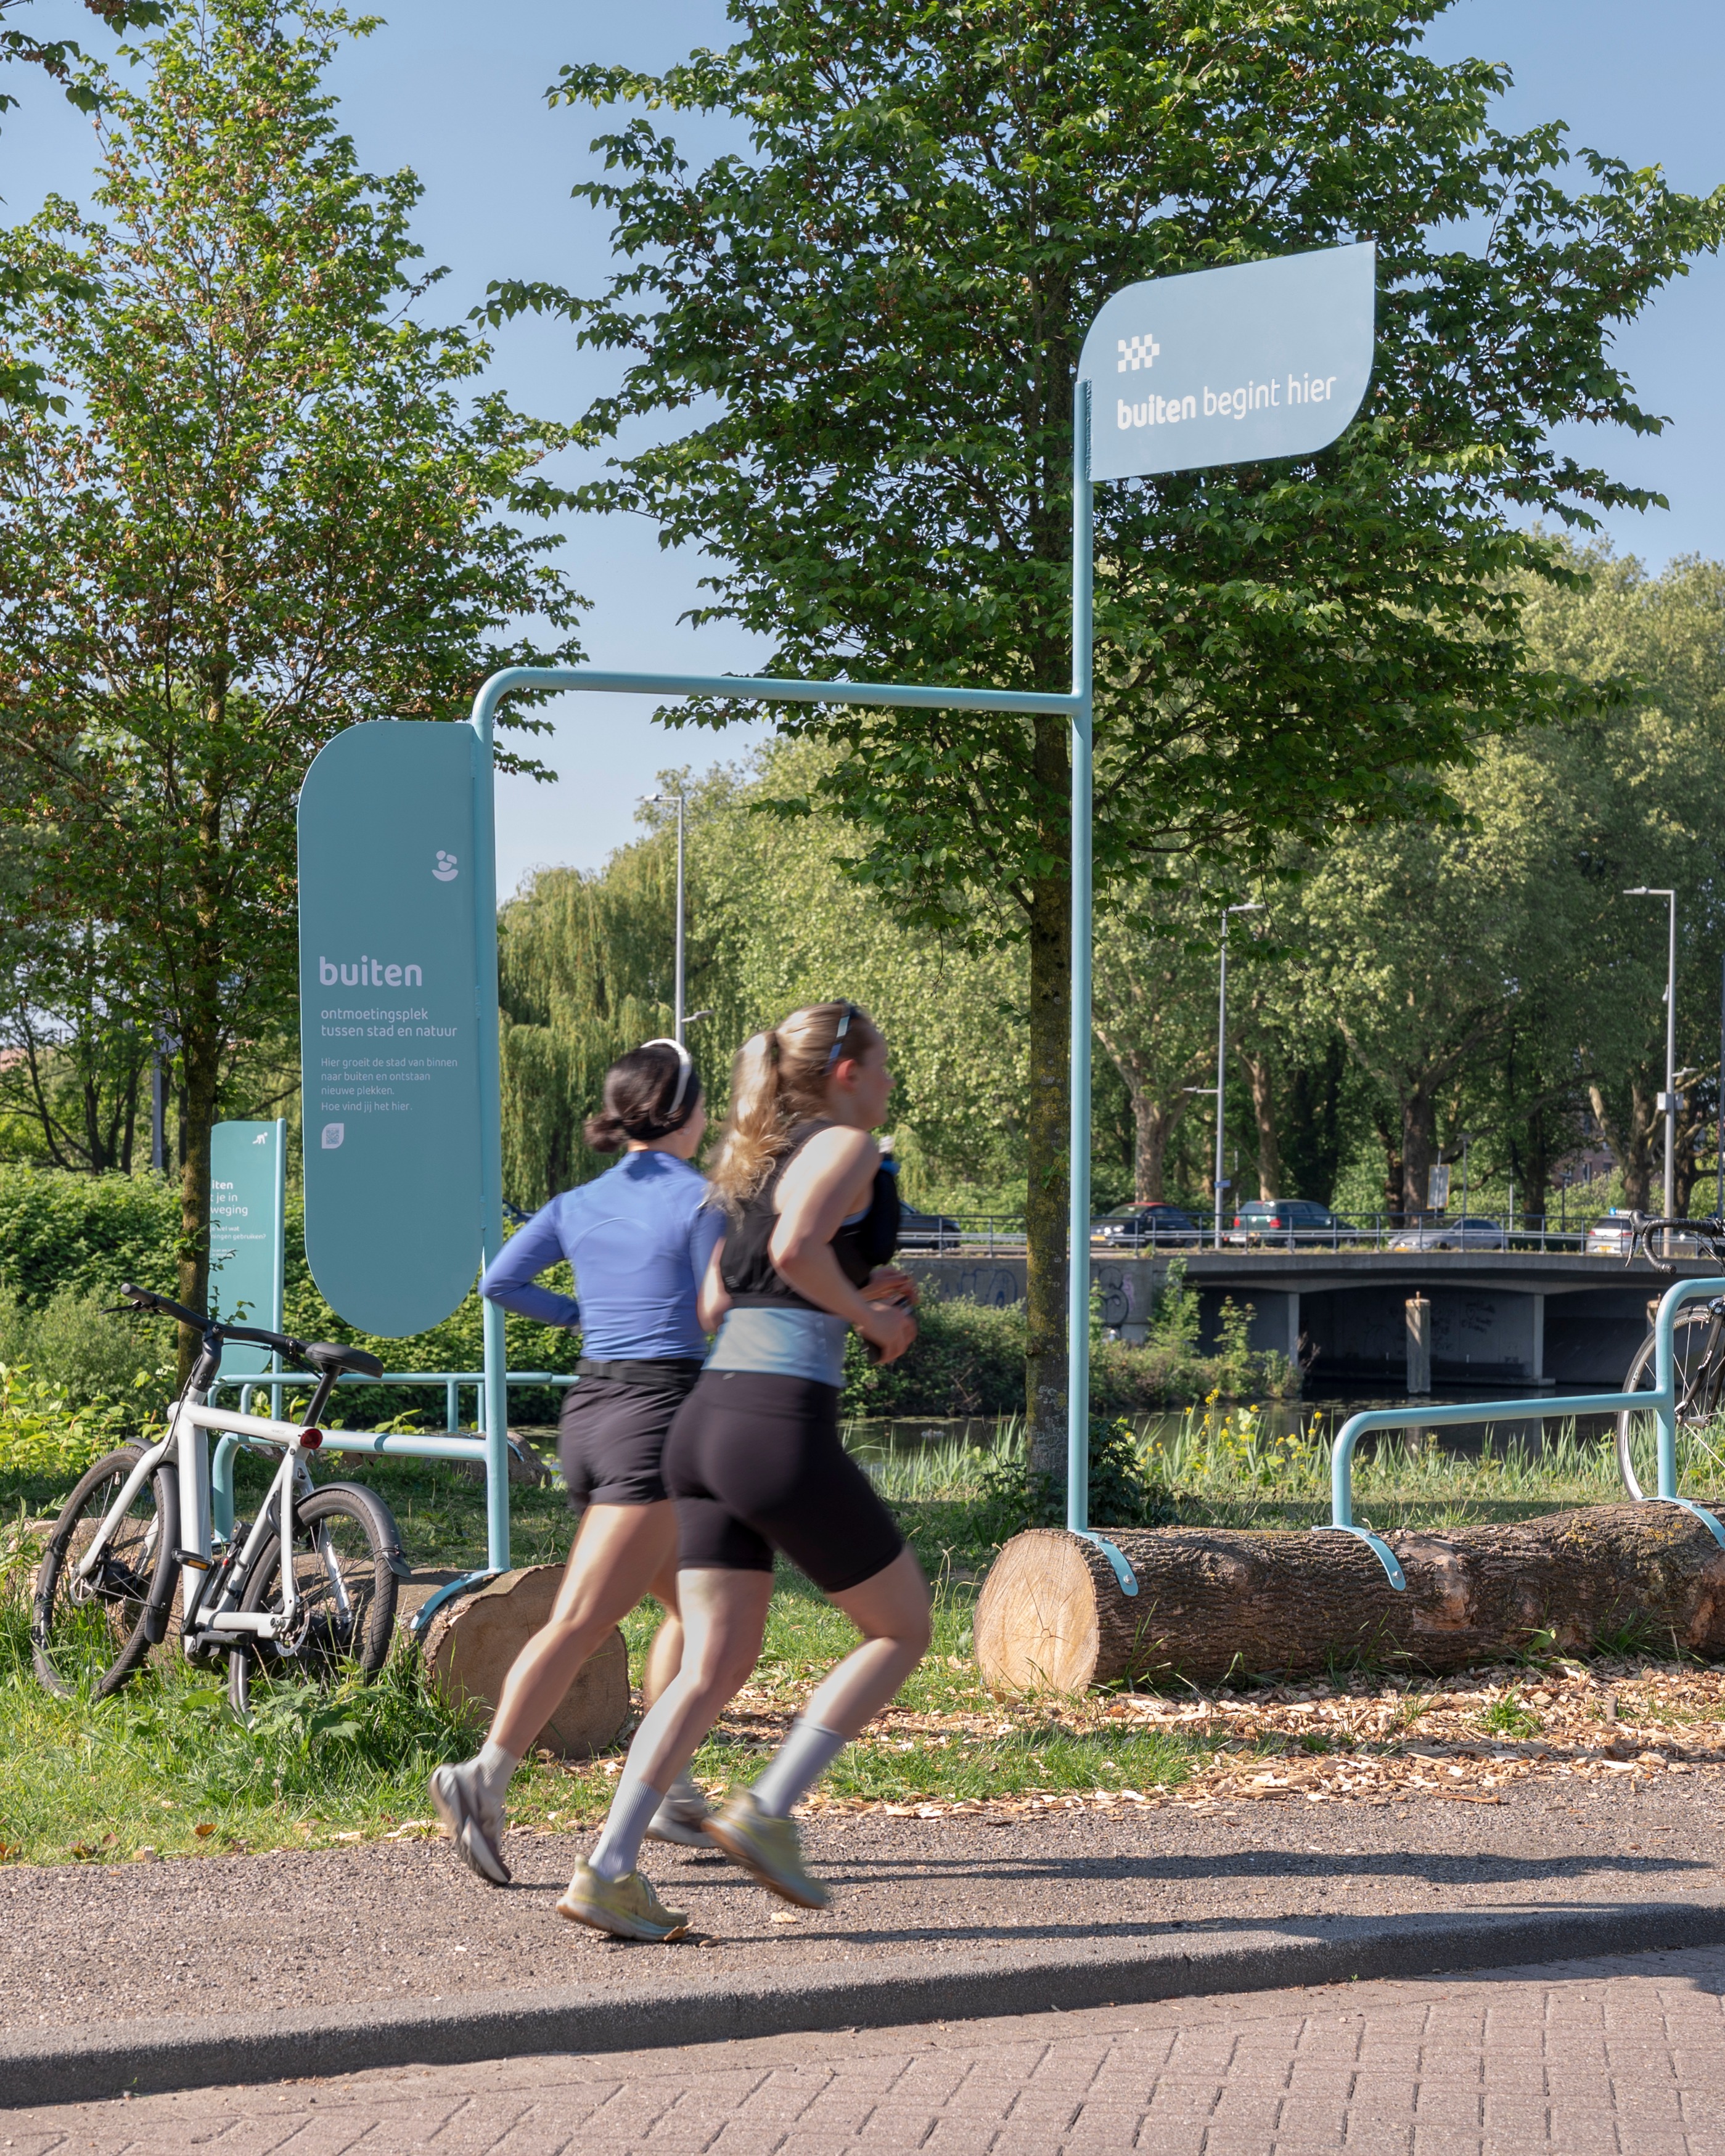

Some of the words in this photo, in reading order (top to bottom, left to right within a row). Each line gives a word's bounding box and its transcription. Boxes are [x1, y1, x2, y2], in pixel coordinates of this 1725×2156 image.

[1117, 394, 1196, 430] buiten
[1203, 378, 1280, 420] begint
[1288, 372, 1337, 405] hier
[319, 955, 422, 987] buiten
[321, 1007, 428, 1023] ontmoetingsplek
[321, 1025, 364, 1037] tussen
[367, 1024, 394, 1037] stad
[397, 1027, 412, 1037] en
[416, 1025, 457, 1037] natuur
[321, 1058, 340, 1067] Hier
[342, 1057, 370, 1069] groeit
[372, 1058, 384, 1067] de
[386, 1058, 406, 1067] stad
[427, 1058, 457, 1067] binnen
[321, 1073, 342, 1081] naar
[344, 1071, 373, 1081] buiten
[389, 1072, 430, 1081] ontstaan
[321, 1085, 355, 1095] nieuwe
[357, 1085, 395, 1096] plekken.
[321, 1101, 340, 1111] Hoe
[342, 1101, 362, 1111] vind
[364, 1101, 372, 1113] jij
[374, 1101, 390, 1111] het
[391, 1101, 412, 1111] hier.
[211, 1180, 233, 1190] iten
[216, 1193, 226, 1204] je
[228, 1193, 238, 1202] in
[210, 1205, 248, 1217] weging
